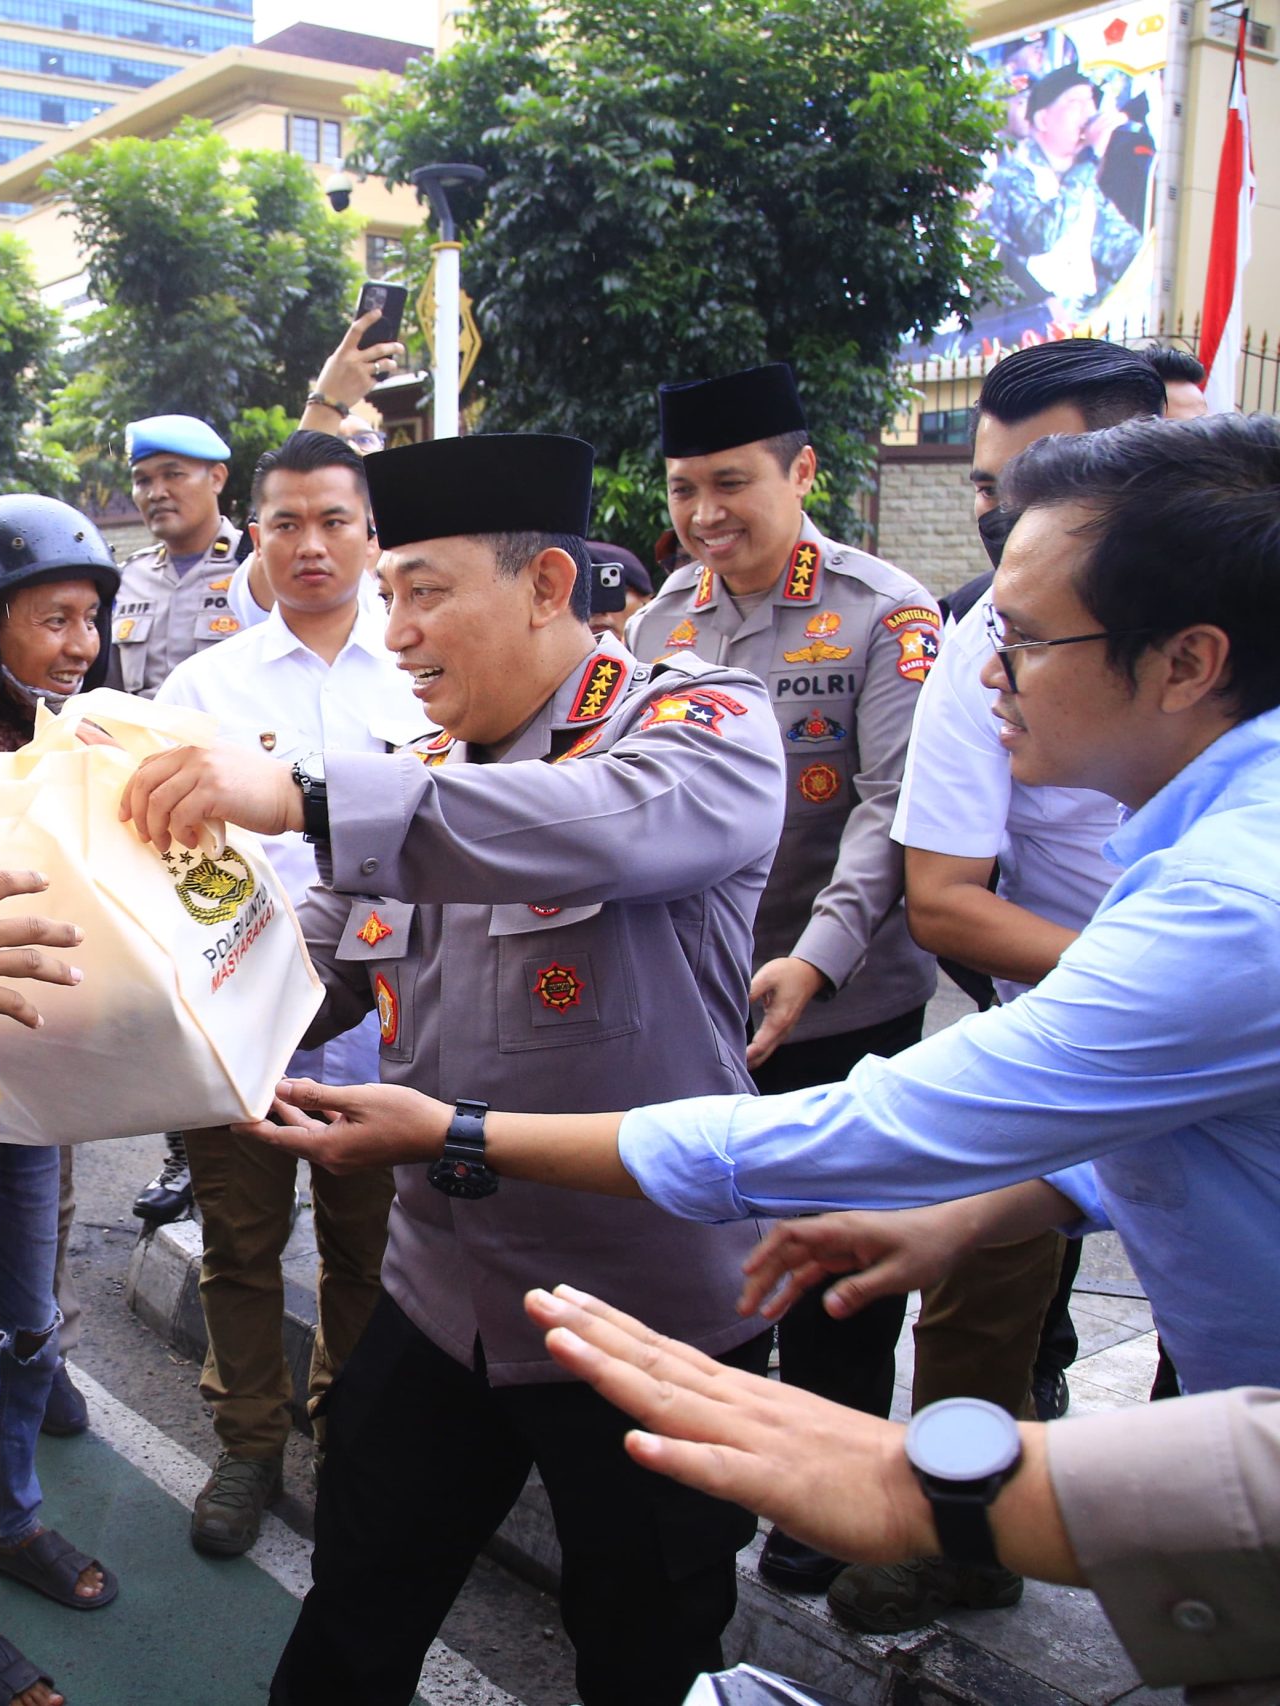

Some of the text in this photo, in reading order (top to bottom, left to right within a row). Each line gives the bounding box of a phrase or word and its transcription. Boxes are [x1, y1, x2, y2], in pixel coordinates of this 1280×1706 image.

[204, 597, 229, 608] PO
[900, 659, 924, 672] MABES
[777, 674, 855, 697] POLRI
[203, 882, 269, 969] POLRI UNTU
